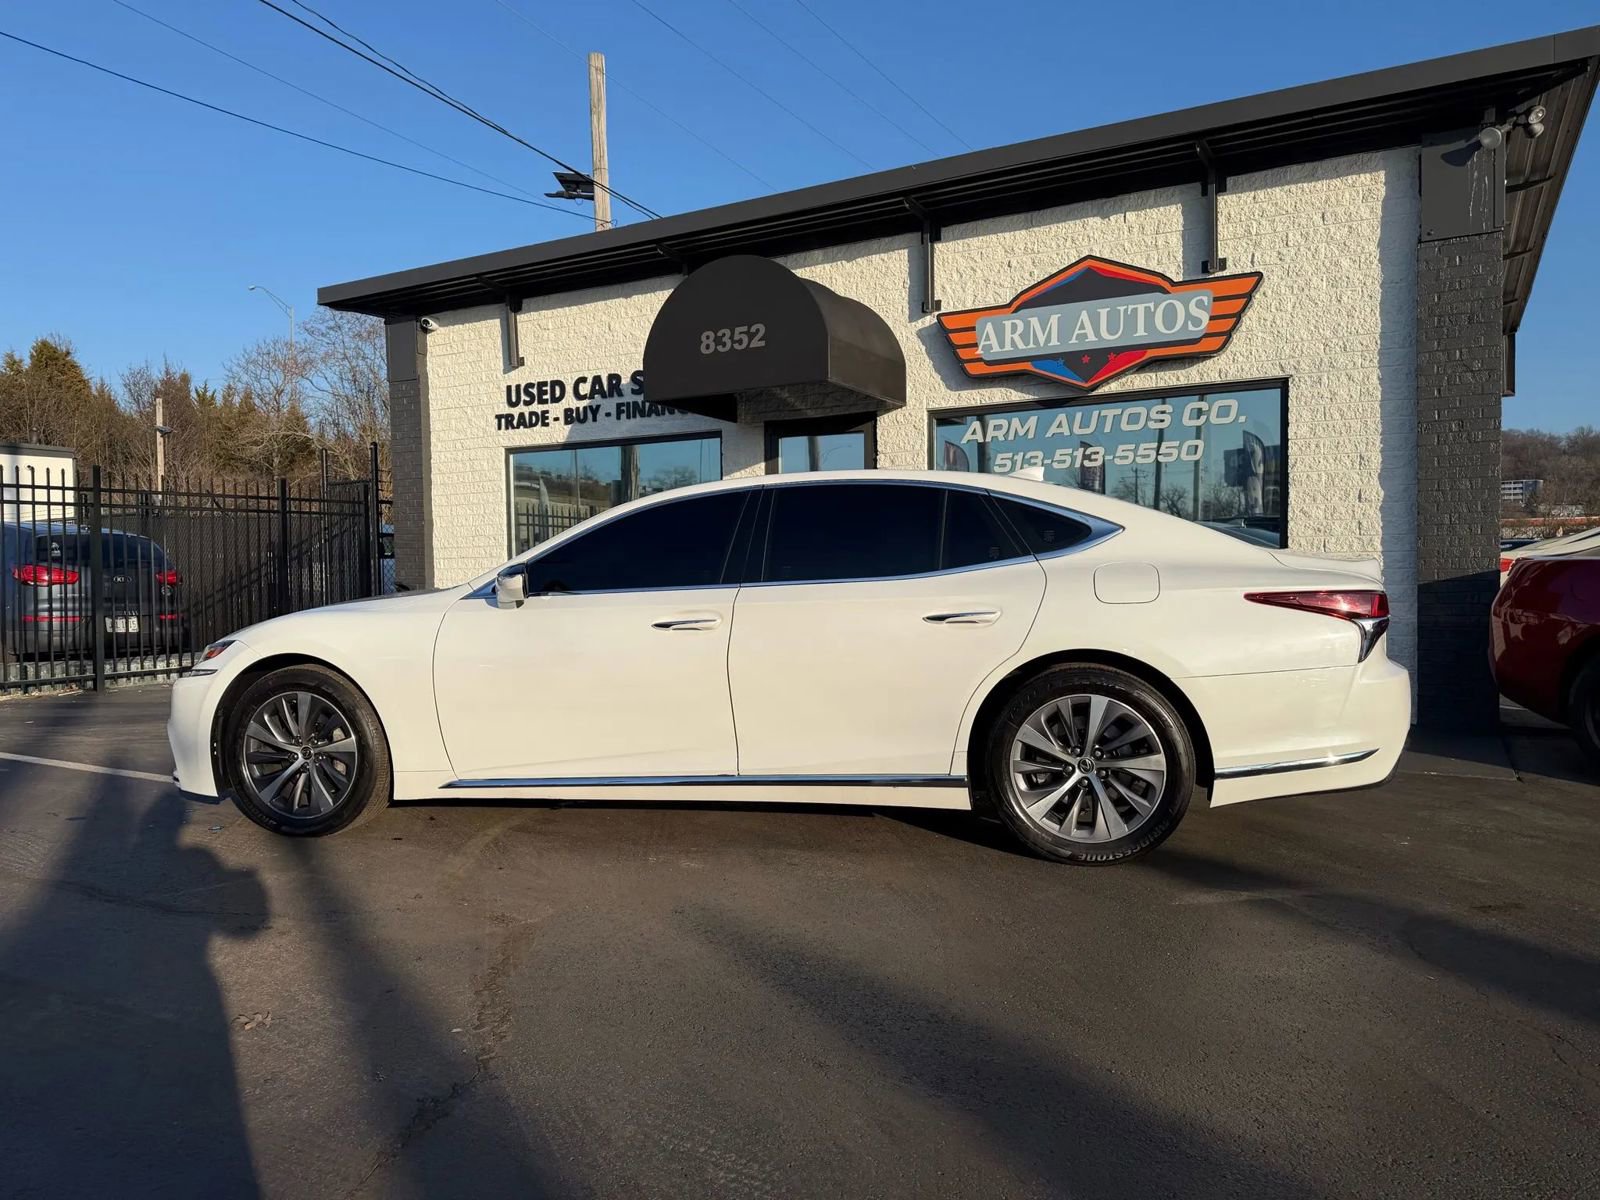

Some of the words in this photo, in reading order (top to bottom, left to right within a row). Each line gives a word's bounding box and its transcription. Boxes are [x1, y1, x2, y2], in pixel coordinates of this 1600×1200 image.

[700, 323, 766, 354] 8352
[976, 313, 1062, 354] ARM
[1069, 295, 1210, 344] AUTOS
[506, 379, 566, 408] USED
[573, 373, 624, 401] CAR
[495, 410, 549, 431] TRADE
[564, 404, 602, 425] BUY
[961, 416, 1038, 444] ARM
[1045, 404, 1173, 438] AUTOS
[1182, 398, 1247, 427] CO.
[994, 439, 1205, 473] 513-513-5550
